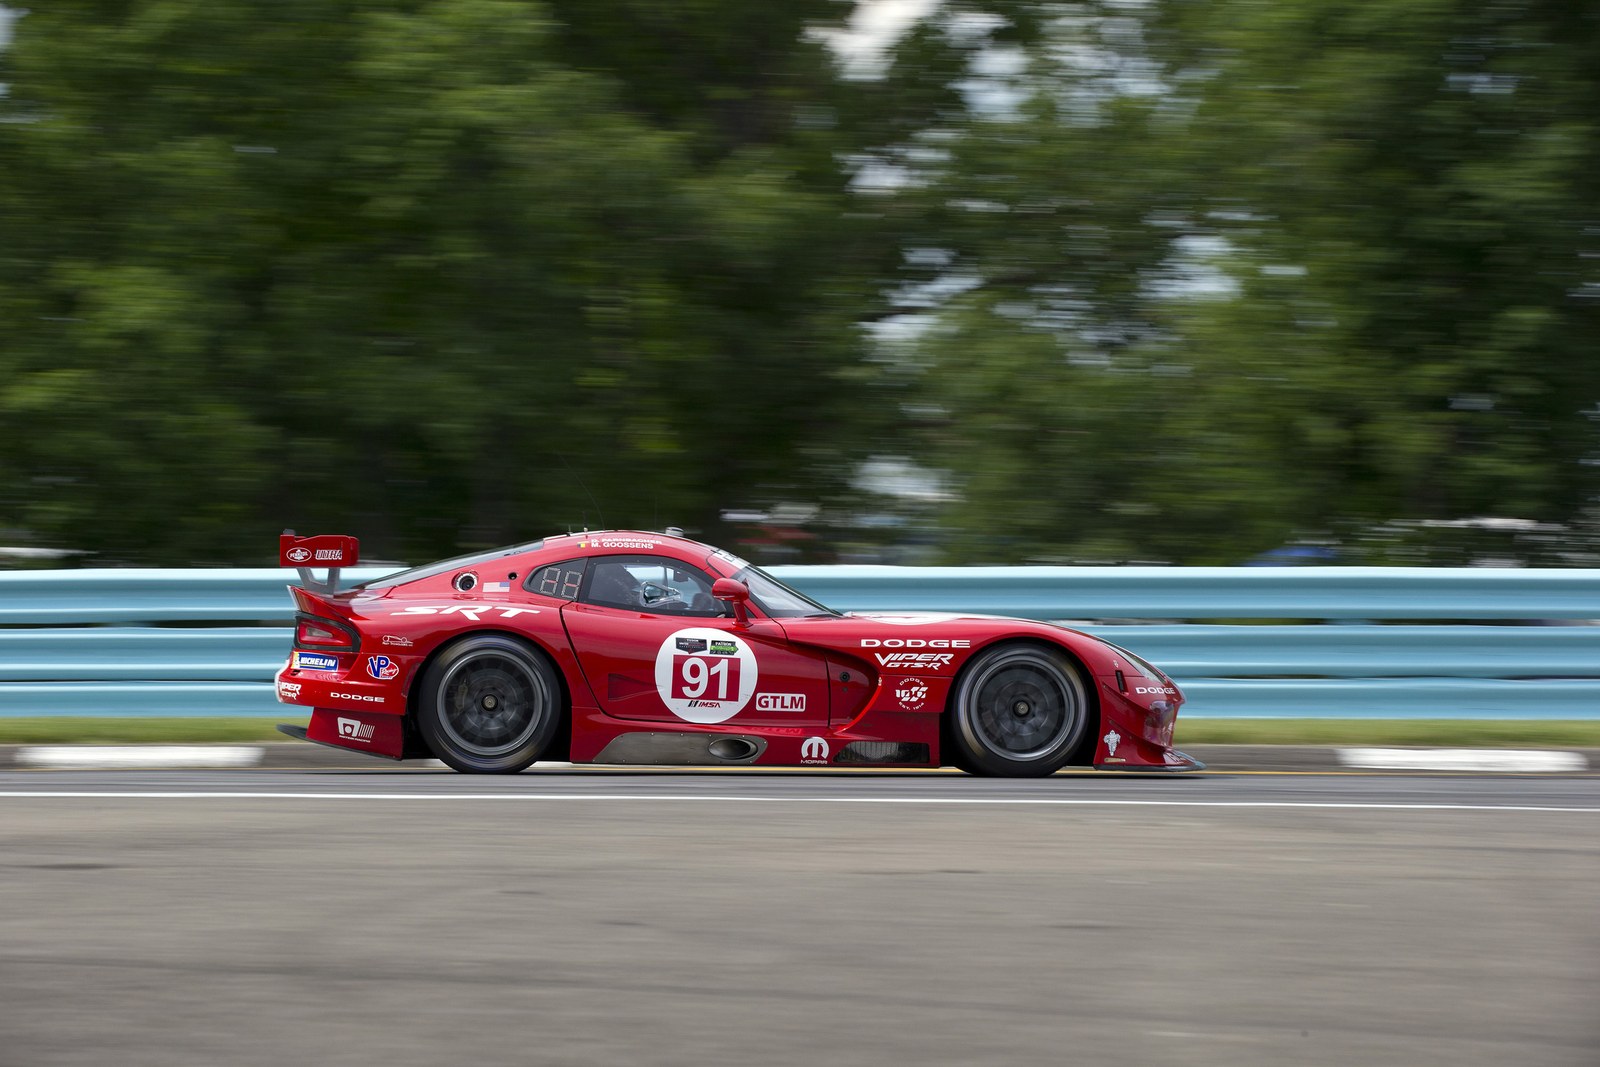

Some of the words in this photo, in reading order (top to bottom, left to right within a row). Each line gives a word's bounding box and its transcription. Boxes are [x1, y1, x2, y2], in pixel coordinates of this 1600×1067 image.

[603, 541, 654, 549] GOOSSENS
[390, 605, 541, 621] SRT
[860, 639, 971, 648] DODGE
[300, 656, 336, 667] MICHELIN
[874, 653, 955, 667] VIPER
[369, 655, 390, 679] VP
[682, 657, 729, 699] 91
[899, 677, 925, 686] DODGE
[1135, 686, 1176, 695] DODGE
[330, 692, 385, 703] DODGE
[757, 695, 805, 710] GTLM
